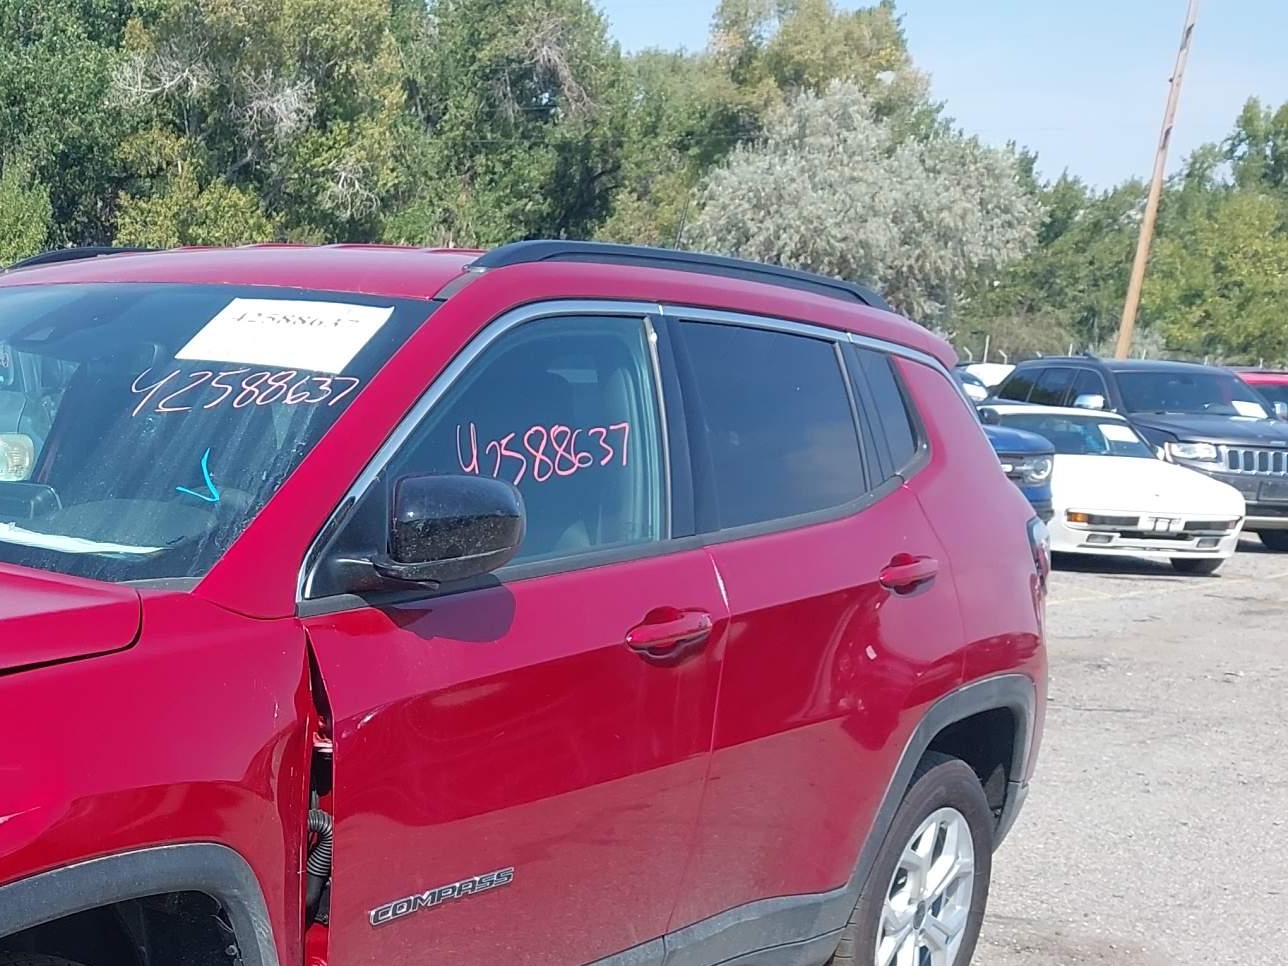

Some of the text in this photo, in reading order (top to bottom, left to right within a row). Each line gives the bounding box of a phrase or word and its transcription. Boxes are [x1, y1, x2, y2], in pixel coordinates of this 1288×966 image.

[131, 367, 361, 417] 42588637
[456, 421, 630, 486] 42588637
[368, 866, 516, 927] COMPASS
